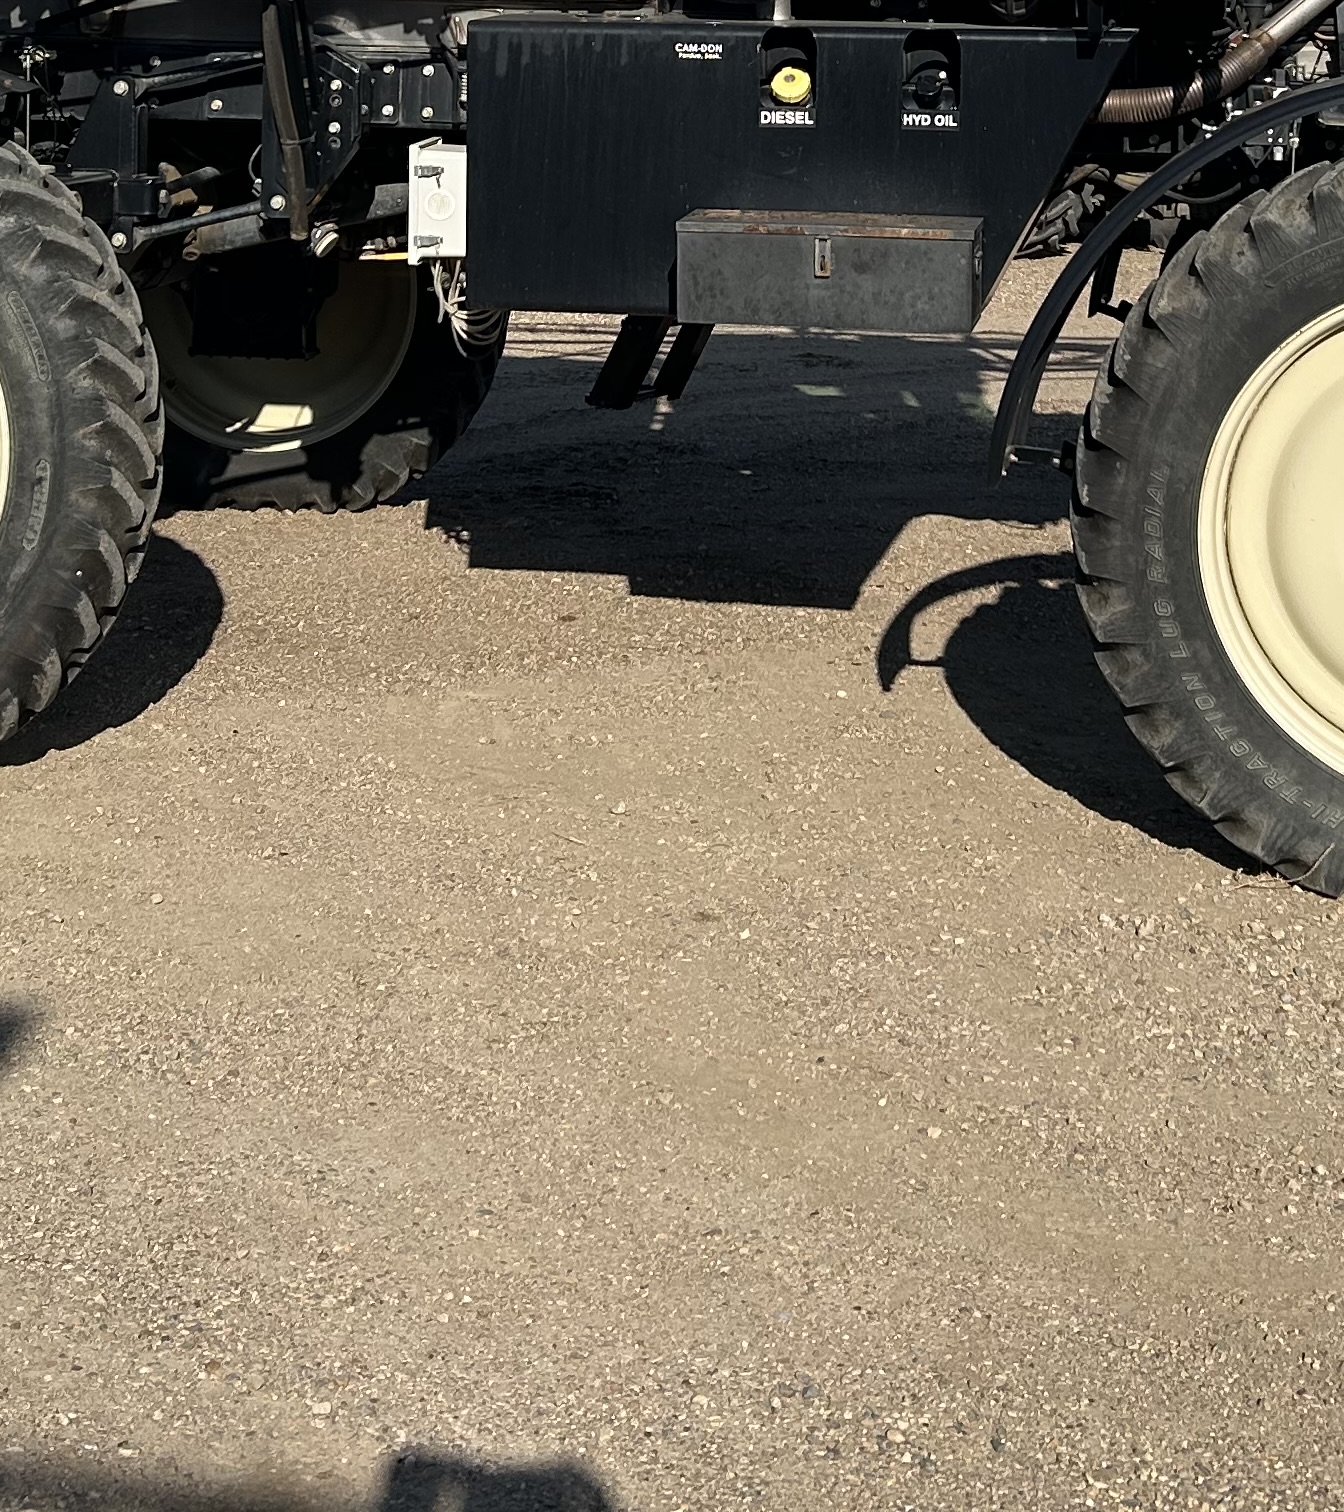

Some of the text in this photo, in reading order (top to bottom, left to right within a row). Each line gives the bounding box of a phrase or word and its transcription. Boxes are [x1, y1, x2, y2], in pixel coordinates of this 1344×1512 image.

[675, 42, 723, 53] CAM-DON
[760, 110, 814, 125] DIESEL
[902, 113, 958, 127] HYD OIL
[1143, 462, 1171, 584] RADIAL
[1153, 597, 1191, 660] LUG
